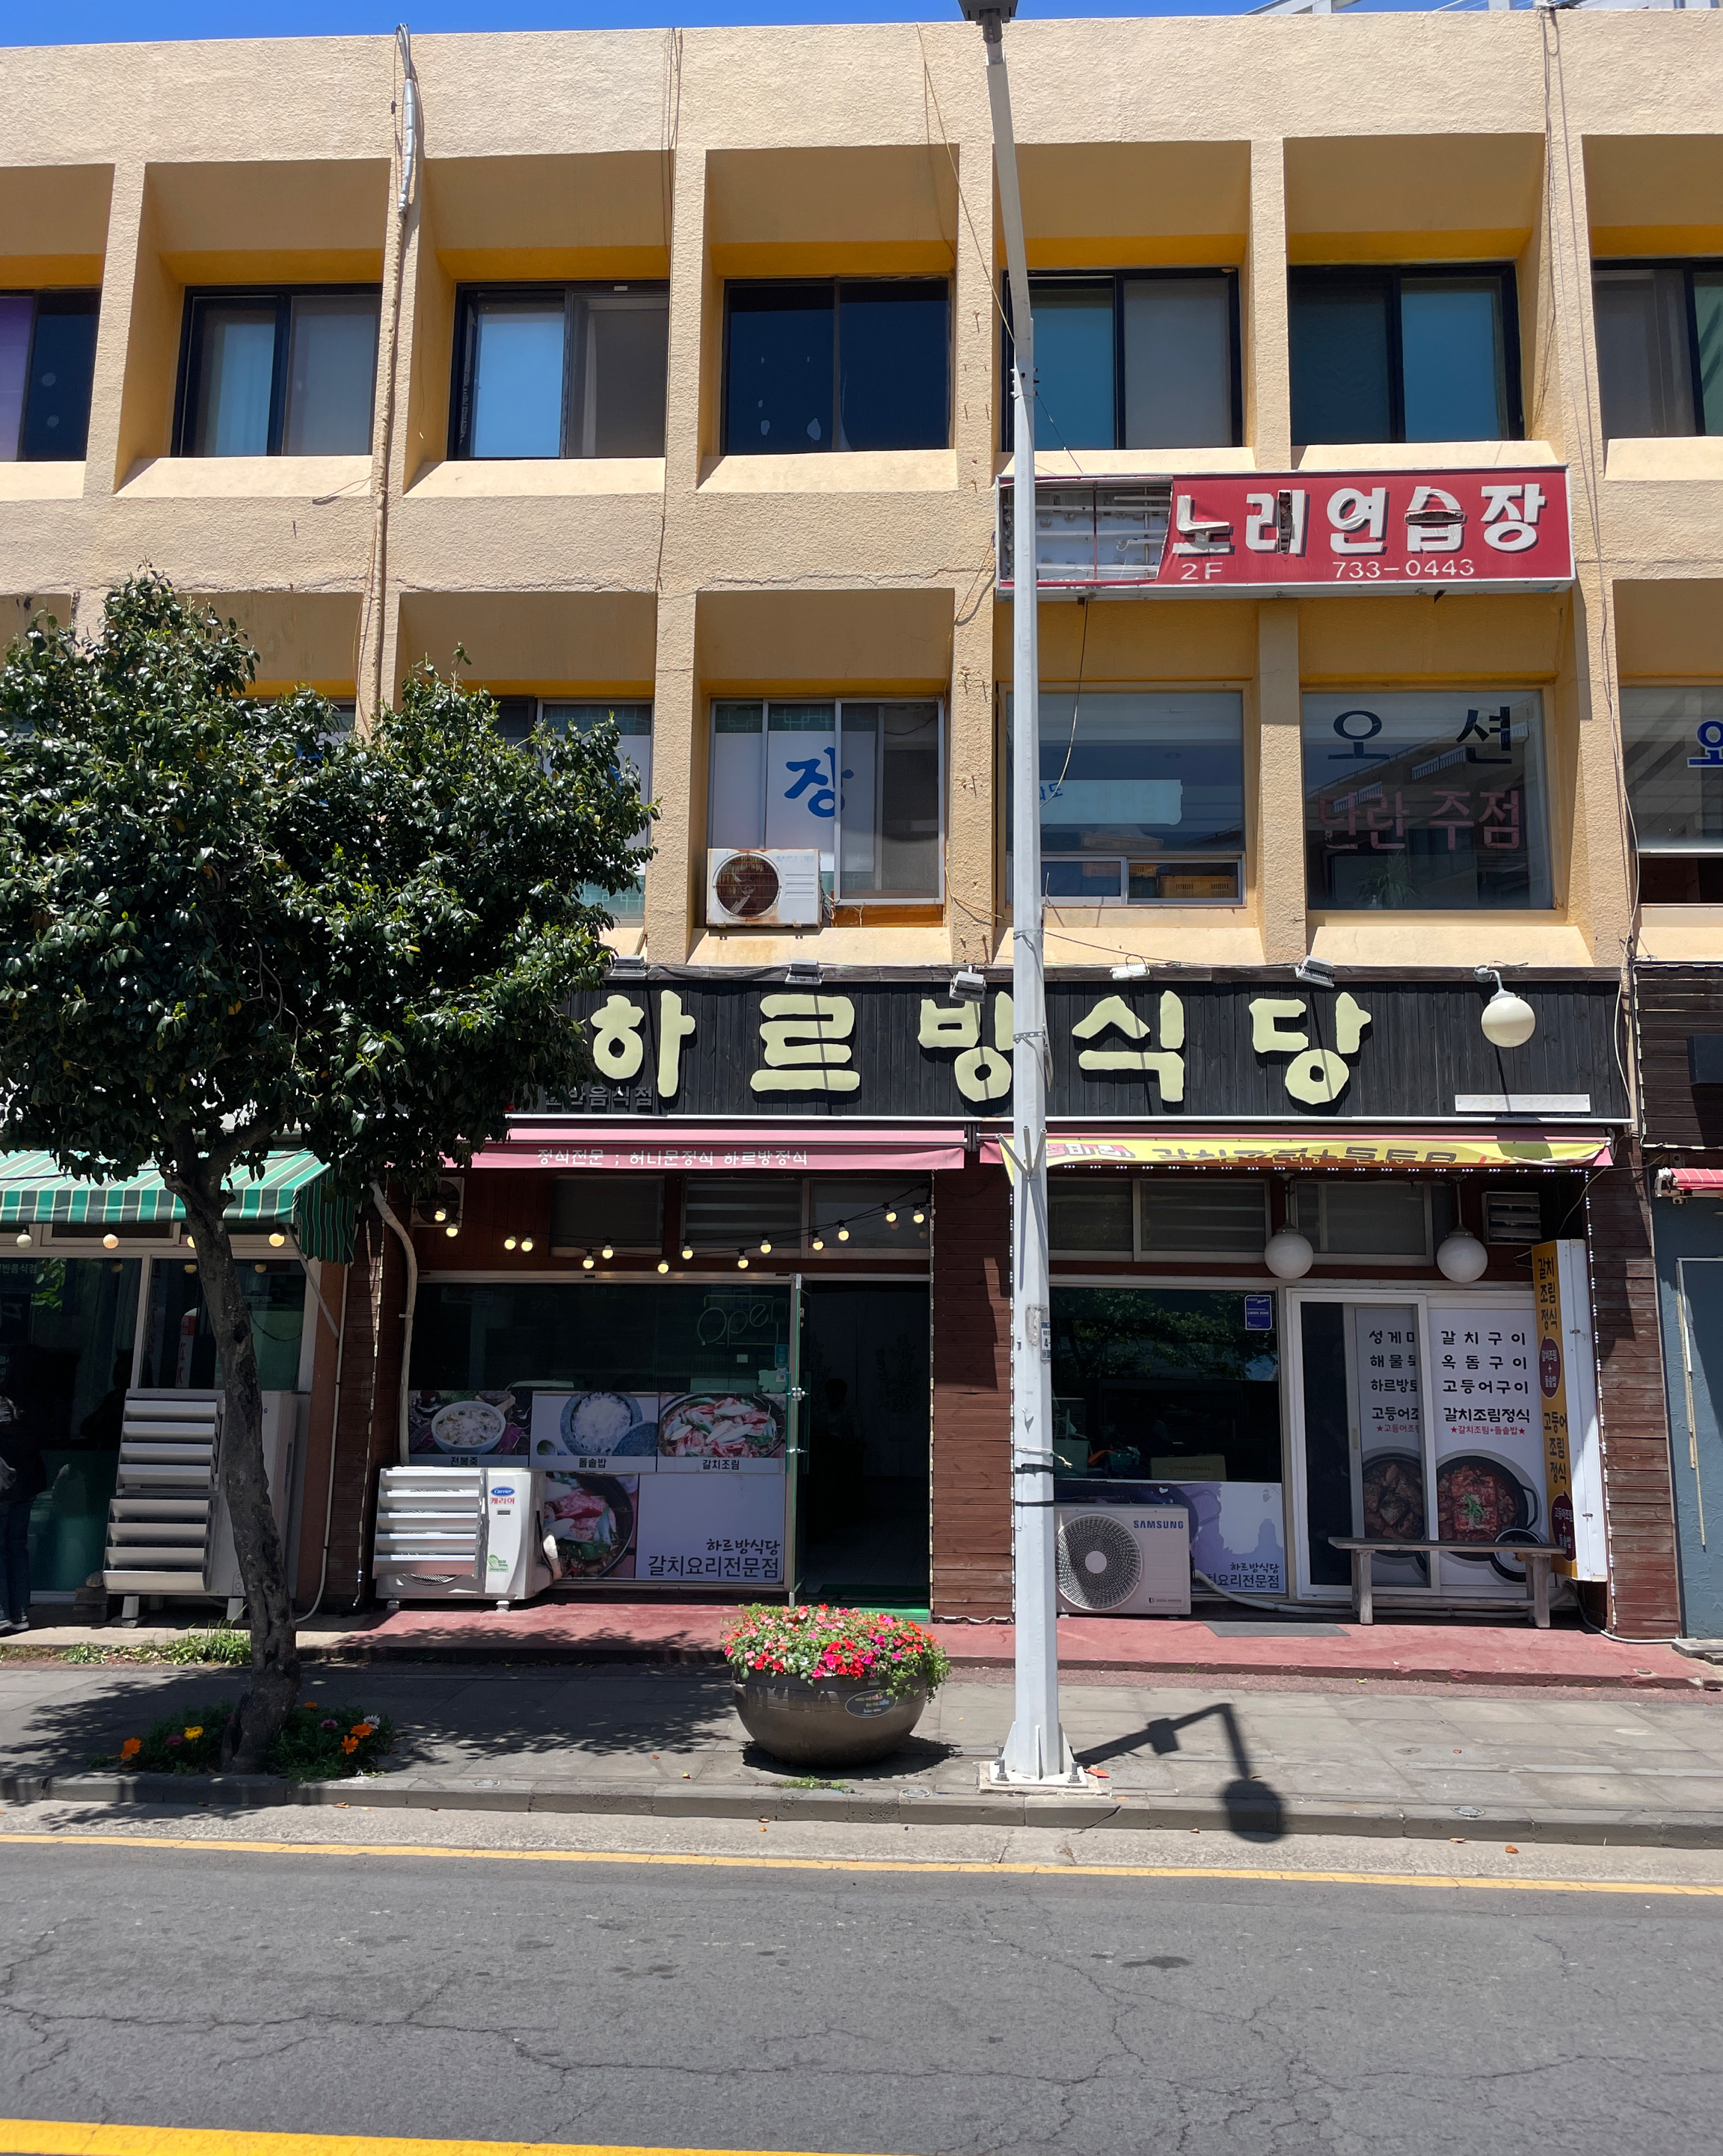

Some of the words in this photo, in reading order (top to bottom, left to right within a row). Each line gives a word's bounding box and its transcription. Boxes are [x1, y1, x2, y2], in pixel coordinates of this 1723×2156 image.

[1171, 483, 1547, 555] 노래연습장
[1179, 562, 1223, 581] 2F
[1332, 559, 1475, 580] 733-0443
[783, 746, 854, 818] 장
[1318, 790, 1410, 850] 단란
[1428, 790, 1520, 851] 주점
[589, 989, 1372, 1105] 하르방식당
[545, 1086, 653, 1106] 반음식점
[1463, 1096, 1579, 1110] 732-3202
[537, 1149, 604, 1165] 정식전문
[629, 1149, 713, 1166] 허니문정식
[724, 1150, 808, 1166] 하르방정식
[1537, 1256, 1555, 1280] 갈치
[1540, 1281, 1556, 1304] 조림
[697, 1298, 787, 1348] Open
[1541, 1307, 1558, 1331] 정식
[1443, 1379, 1529, 1395] 고등어구이
[1443, 1407, 1530, 1423] 갈치조림정식
[1544, 1411, 1567, 1434] 고등어
[1549, 1437, 1565, 1459] 조림
[450, 1456, 479, 1466] 전복죽
[578, 1457, 607, 1469] 돌솥밥
[701, 1458, 740, 1471] 갈치조림
[1550, 1461, 1567, 1484] 정식
[1133, 1520, 1184, 1529] SAMSUNG
[706, 1538, 781, 1555] 하르방식당
[648, 1555, 779, 1579] 갈치요리전문점
[1230, 1562, 1280, 1573] 하르방식당
